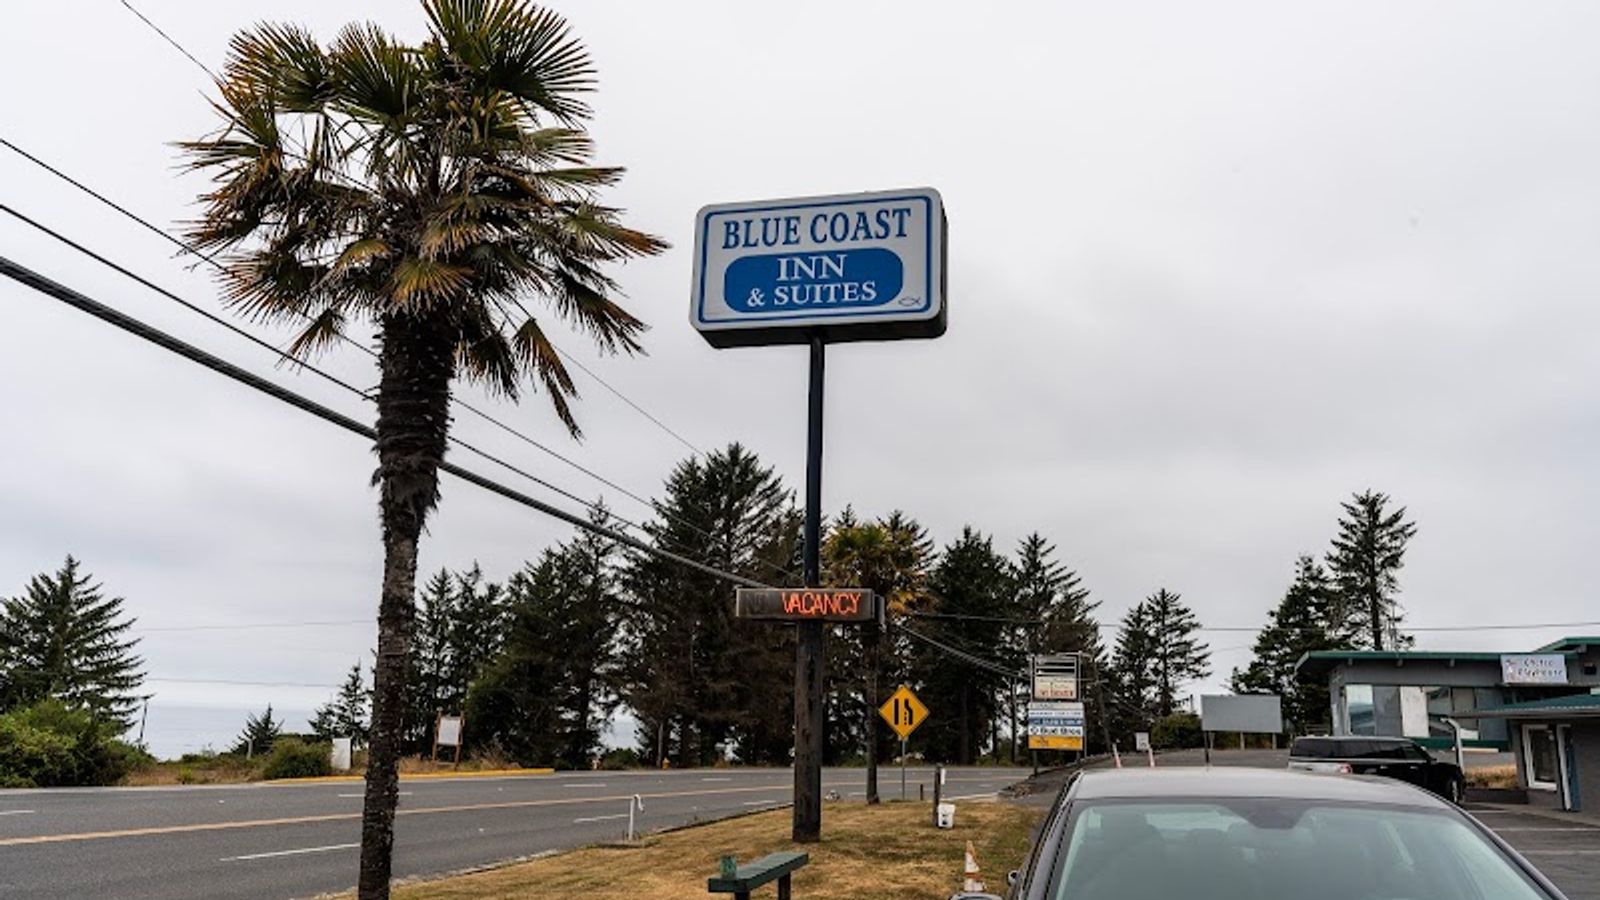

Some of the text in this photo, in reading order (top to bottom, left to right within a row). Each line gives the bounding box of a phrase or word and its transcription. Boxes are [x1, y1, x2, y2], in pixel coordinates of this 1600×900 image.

[722, 208, 911, 249] BLUE COAST
[776, 254, 847, 281] INN
[747, 281, 877, 306] & SUITES
[782, 592, 861, 614] VACANCY
